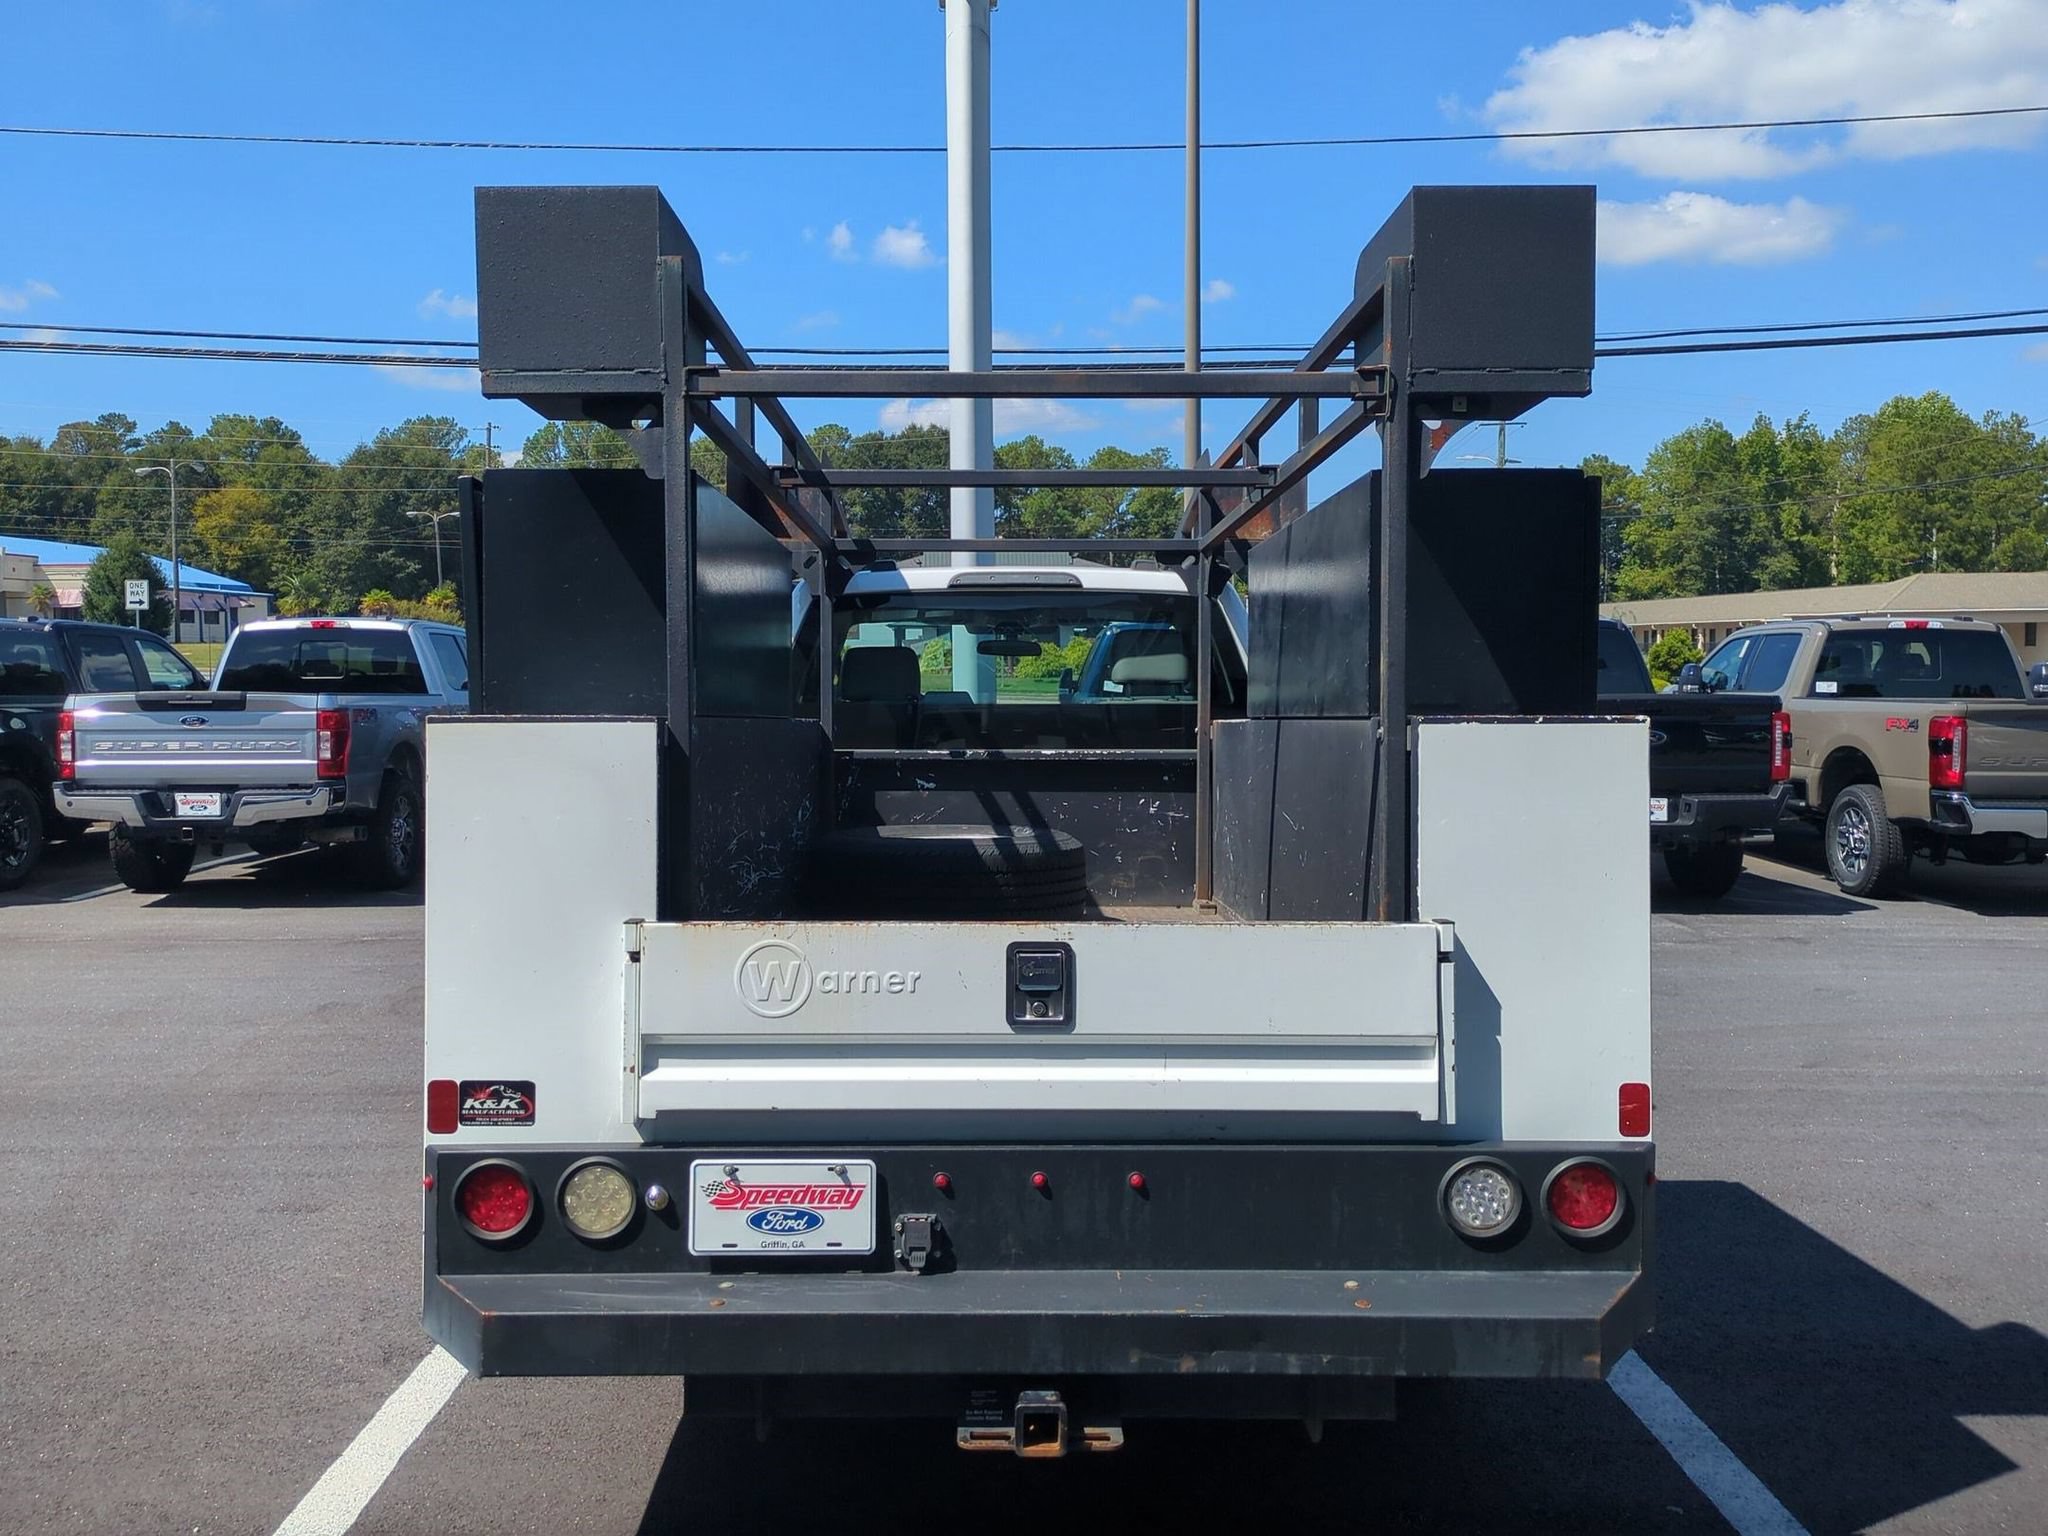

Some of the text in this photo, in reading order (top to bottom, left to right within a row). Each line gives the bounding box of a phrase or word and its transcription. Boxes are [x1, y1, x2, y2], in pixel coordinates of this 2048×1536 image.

[1885, 717, 1919, 731] FX4
[95, 740, 298, 750] SUPER DUTY
[745, 958, 921, 1005] Warner
[463, 1098, 521, 1109] K&K
[709, 1179, 867, 1210] Speedway
[761, 1210, 808, 1231] Ford
[761, 1240, 804, 1250] Griffin, GA
